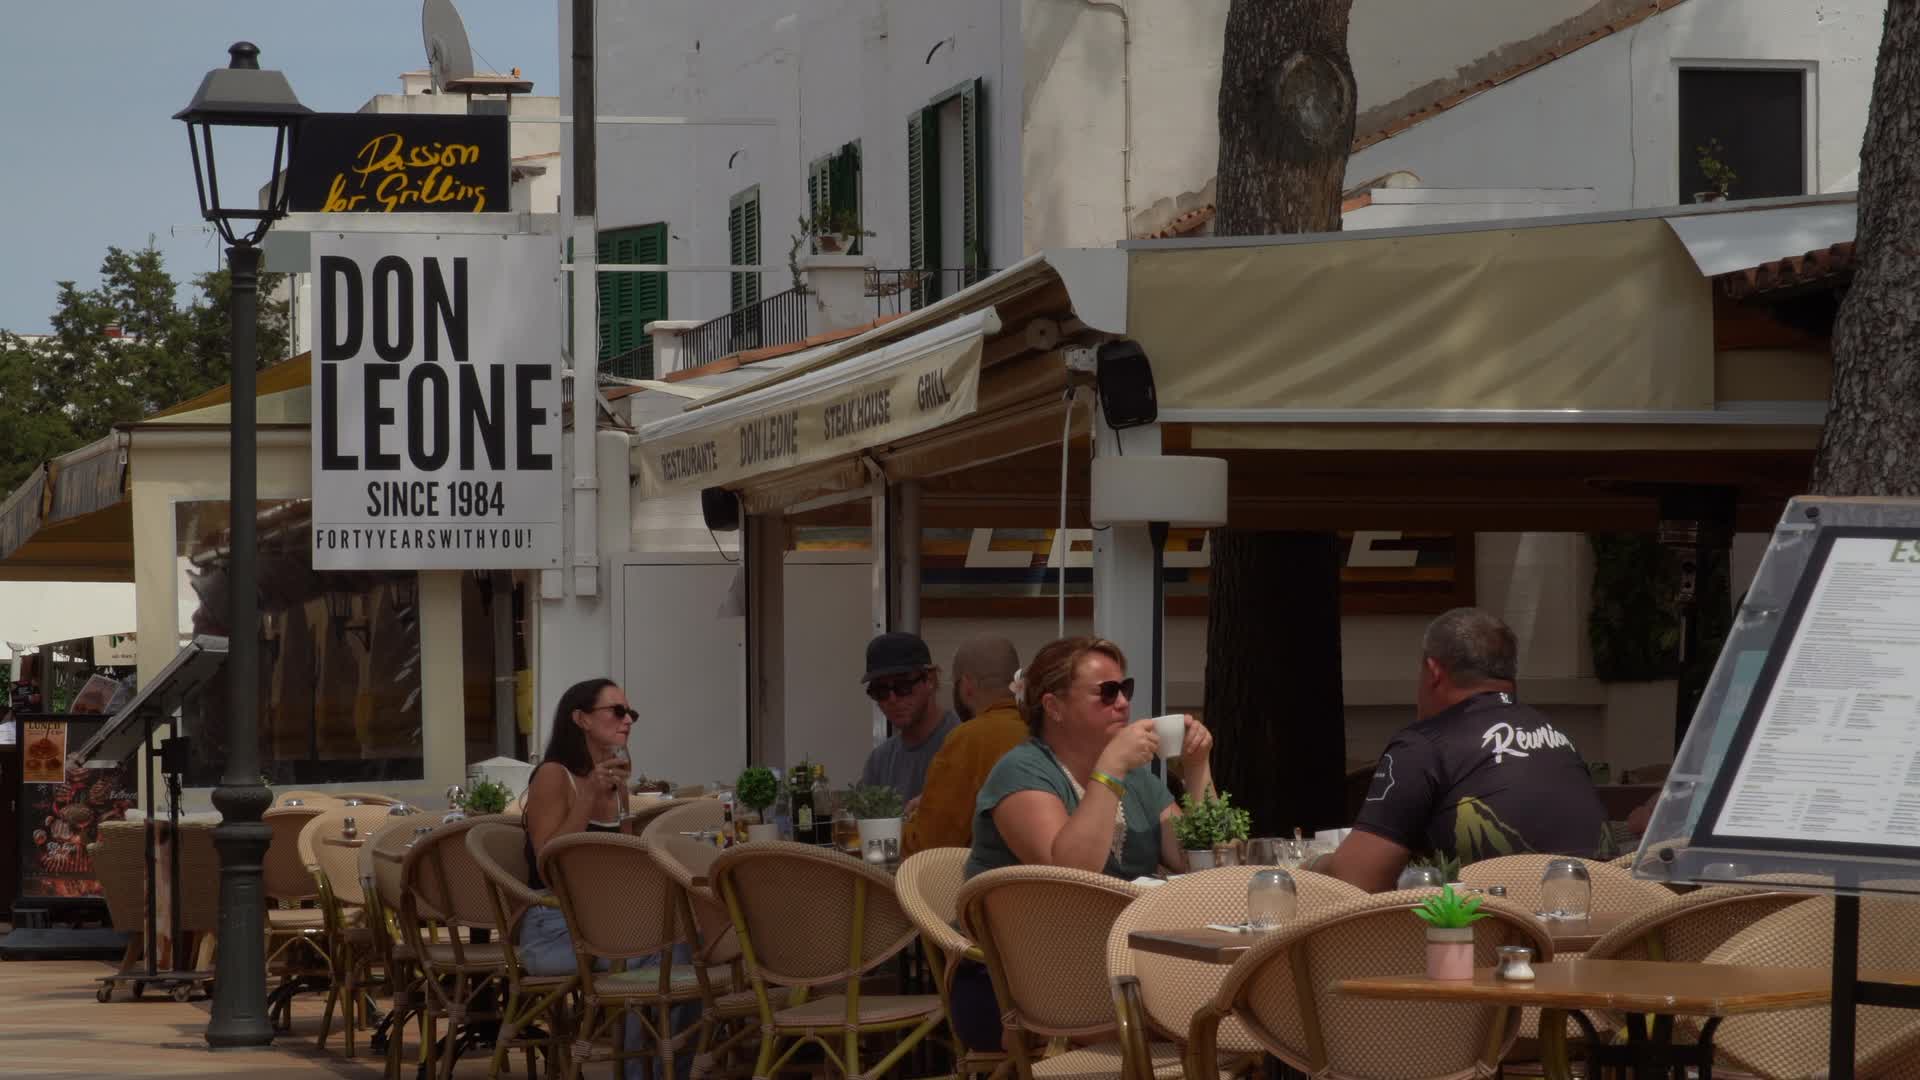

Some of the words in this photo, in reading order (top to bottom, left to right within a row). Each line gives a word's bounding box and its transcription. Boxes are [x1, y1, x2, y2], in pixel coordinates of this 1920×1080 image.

[352, 133, 480, 188] Passion
[376, 166, 488, 213] Grilling
[320, 255, 469, 362] DON
[321, 362, 553, 472] LEONE
[660, 440, 718, 481] RESTAURANTE
[739, 419, 762, 468] DON
[762, 411, 799, 461] LEONE
[824, 398, 856, 441] STEAK
[857, 388, 891, 432] HOUSE
[917, 367, 951, 412] GRILL
[366, 481, 440, 517] SINCE
[447, 481, 505, 517] 1984
